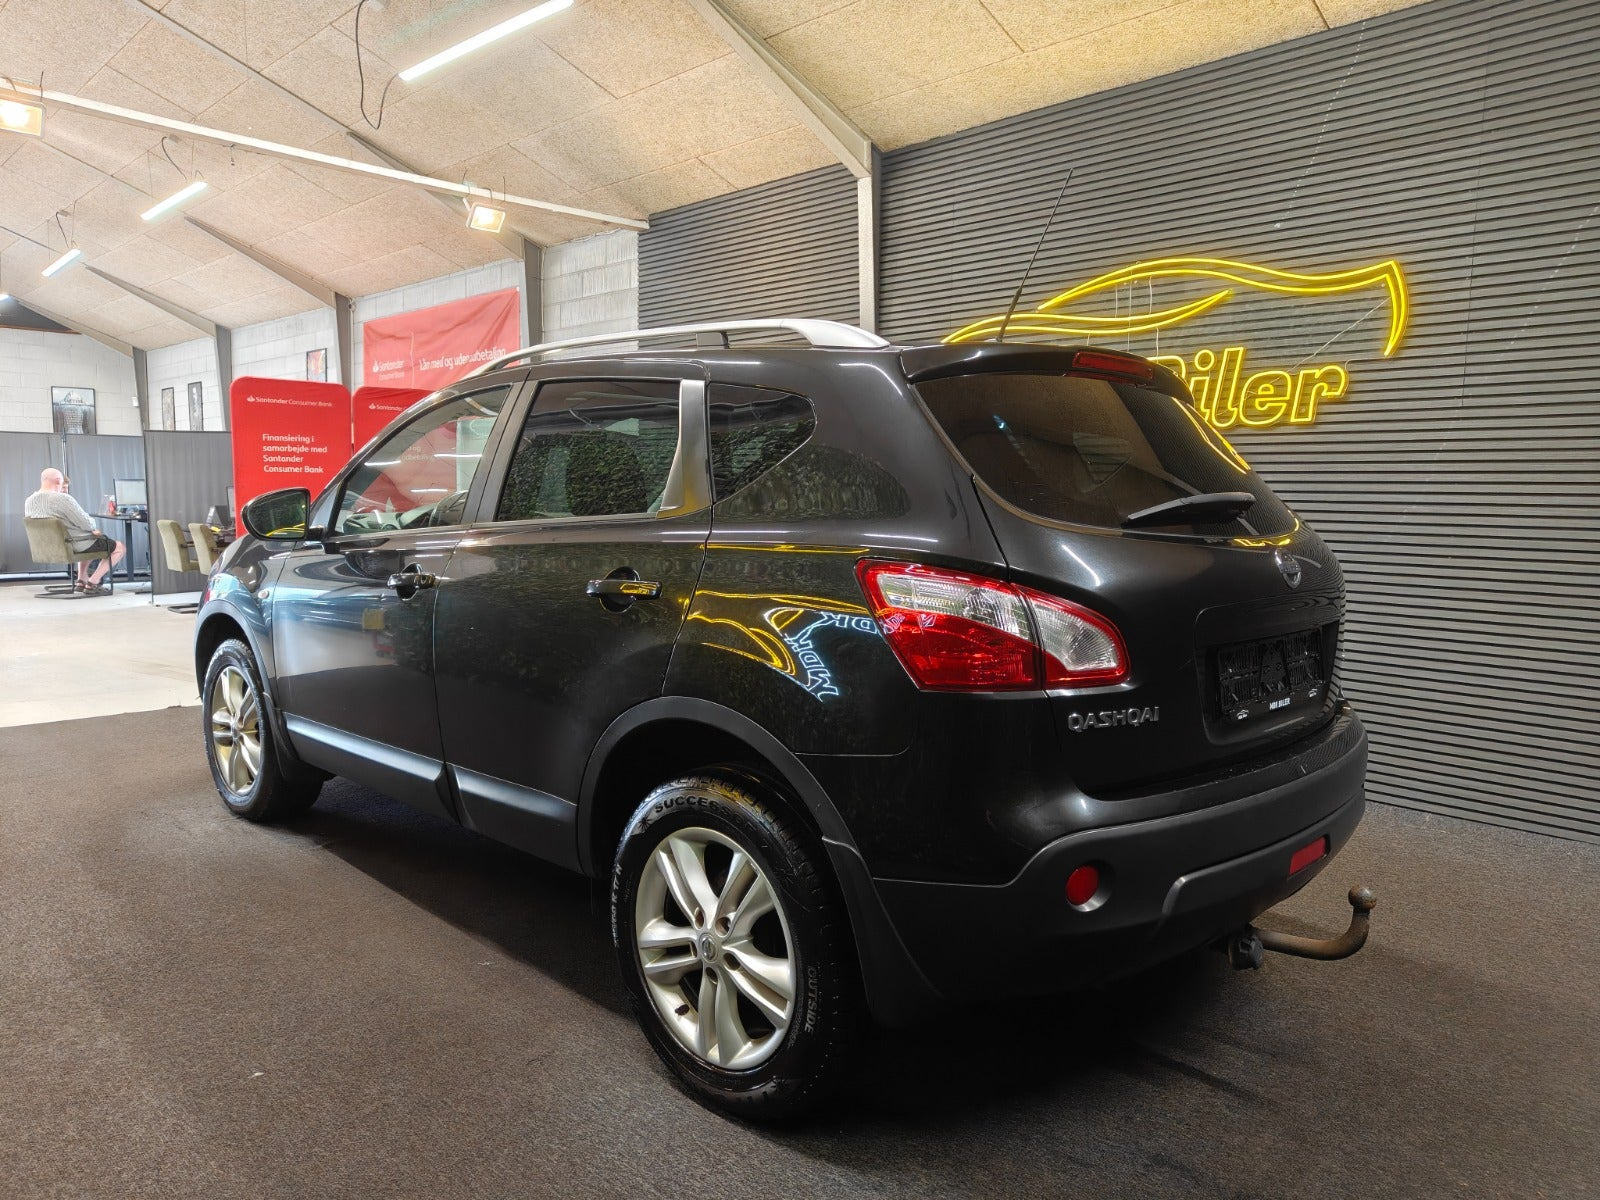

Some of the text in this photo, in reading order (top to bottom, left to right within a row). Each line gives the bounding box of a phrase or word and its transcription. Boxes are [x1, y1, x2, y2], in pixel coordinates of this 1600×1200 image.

[1147, 346, 1347, 428] iler
[255, 396, 288, 405] Santander
[288, 398, 317, 406] Consumer
[262, 433, 311, 444] Finansiering
[262, 444, 309, 454] samarbejde
[262, 454, 304, 463] Santander
[263, 464, 324, 473] Consumer Bank
[1067, 706, 1160, 732] QASHQAI
